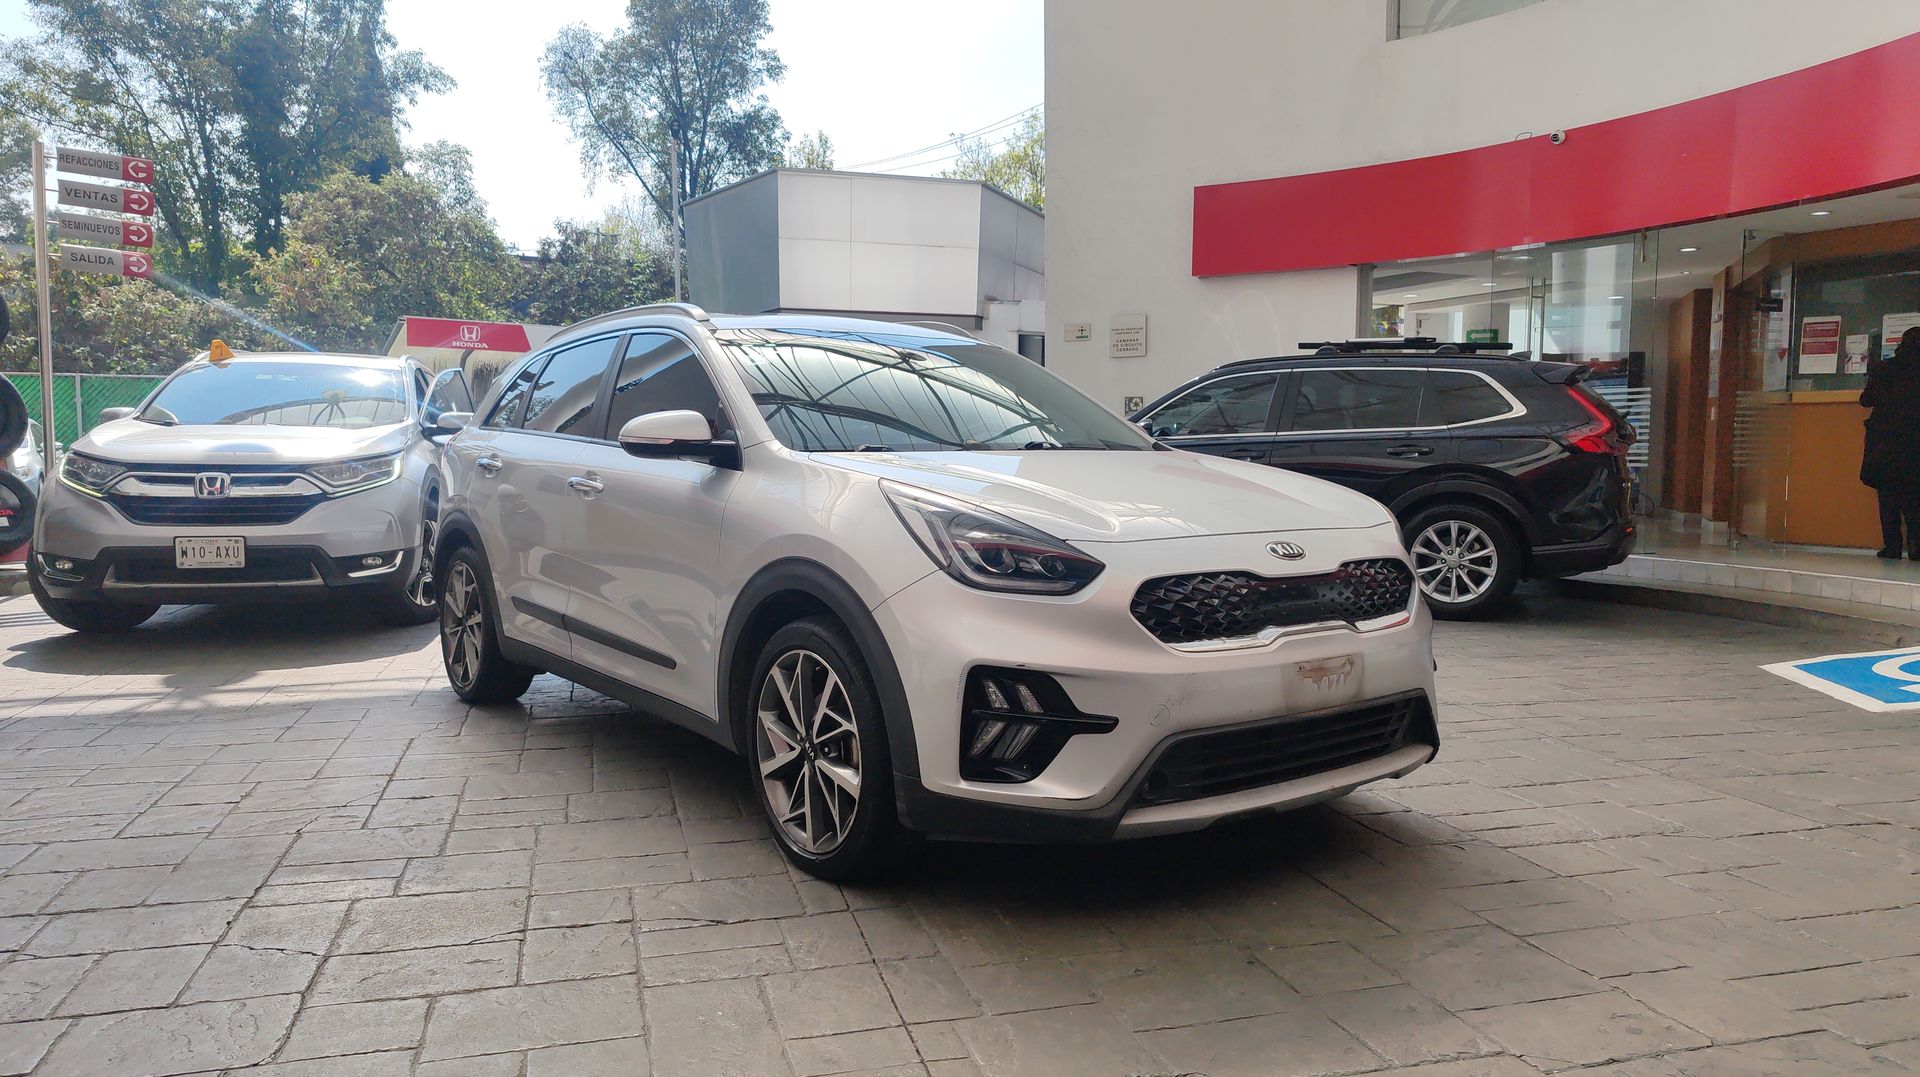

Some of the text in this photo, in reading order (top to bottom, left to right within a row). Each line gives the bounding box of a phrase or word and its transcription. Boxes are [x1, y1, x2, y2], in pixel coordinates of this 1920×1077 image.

[58, 153, 120, 171] REFACCIONES
[64, 187, 119, 204] VENTAS
[61, 219, 121, 236] SEMINUEVOS
[70, 252, 115, 266] SALIDA
[452, 341, 489, 349] HONDA
[180, 545, 240, 559] W10-AXU
[1274, 543, 1304, 556] KIA
